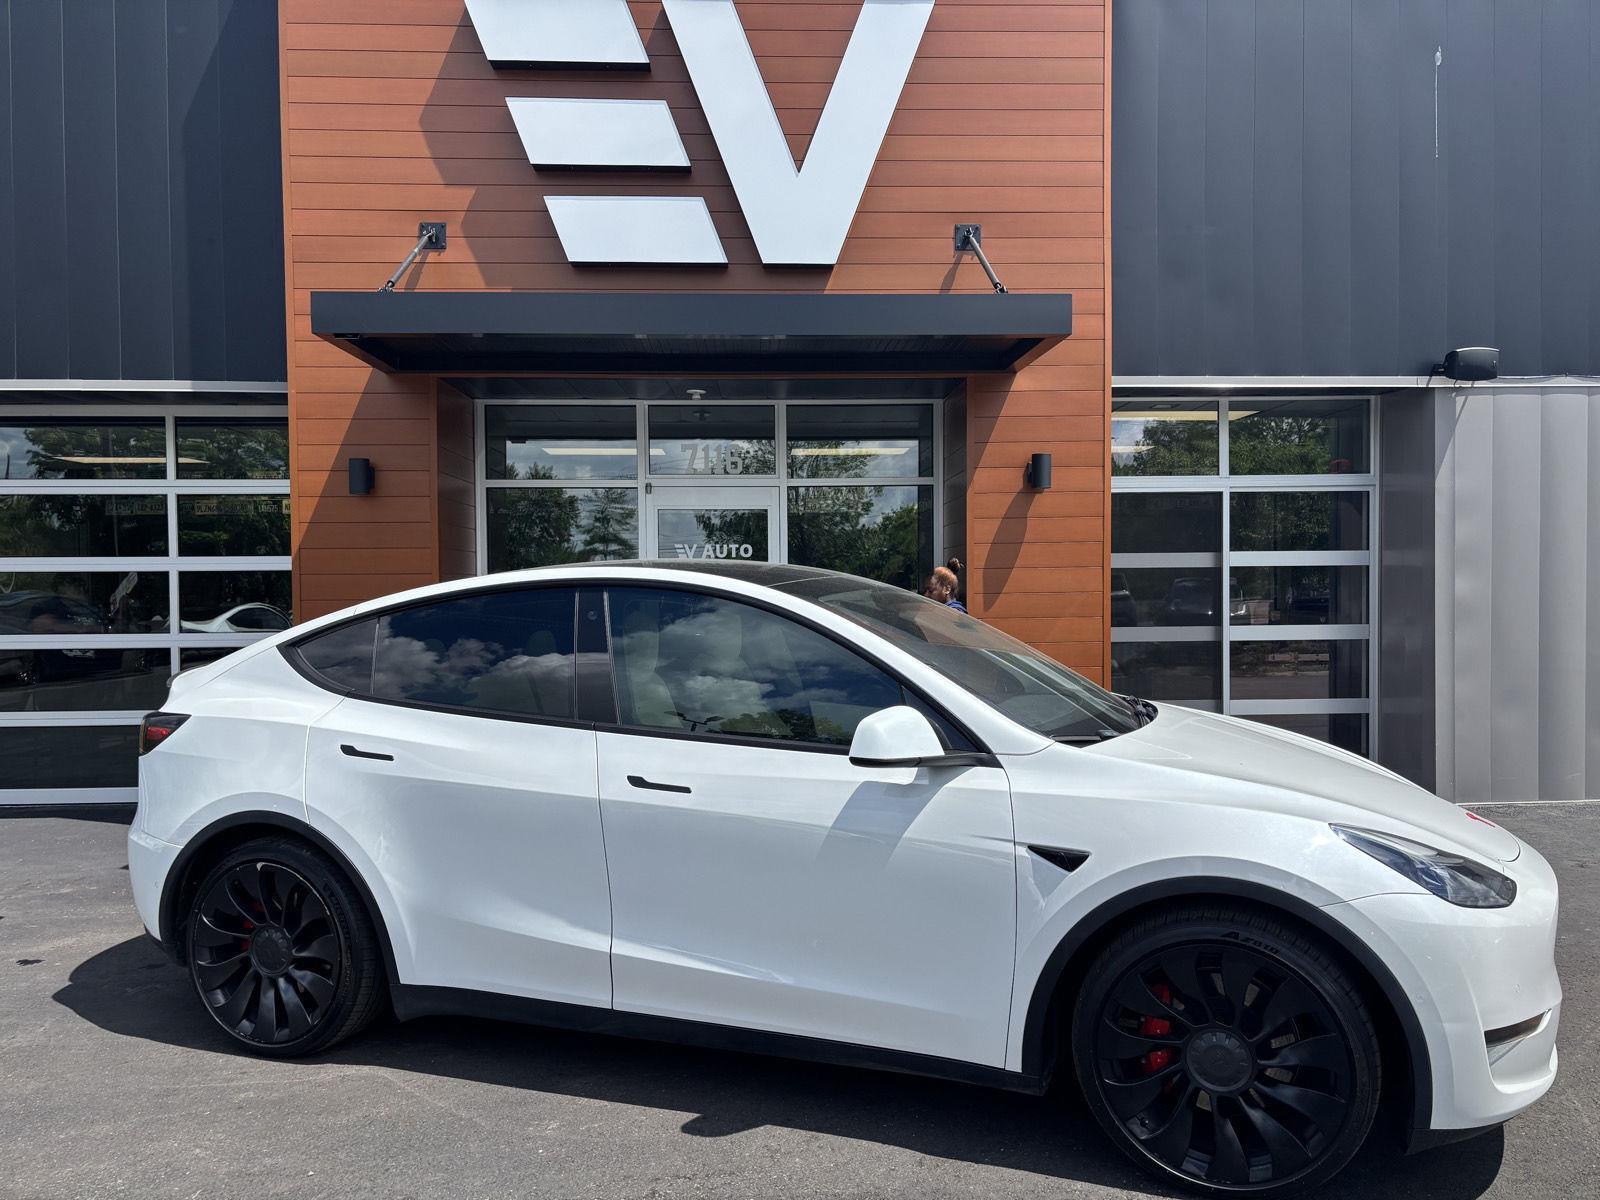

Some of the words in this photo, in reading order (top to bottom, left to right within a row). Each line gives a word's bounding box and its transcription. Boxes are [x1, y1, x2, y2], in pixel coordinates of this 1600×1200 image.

[464, 0, 935, 266] EV
[680, 443, 743, 475] 7116
[674, 543, 698, 559] EV
[701, 543, 753, 559] AUTO
